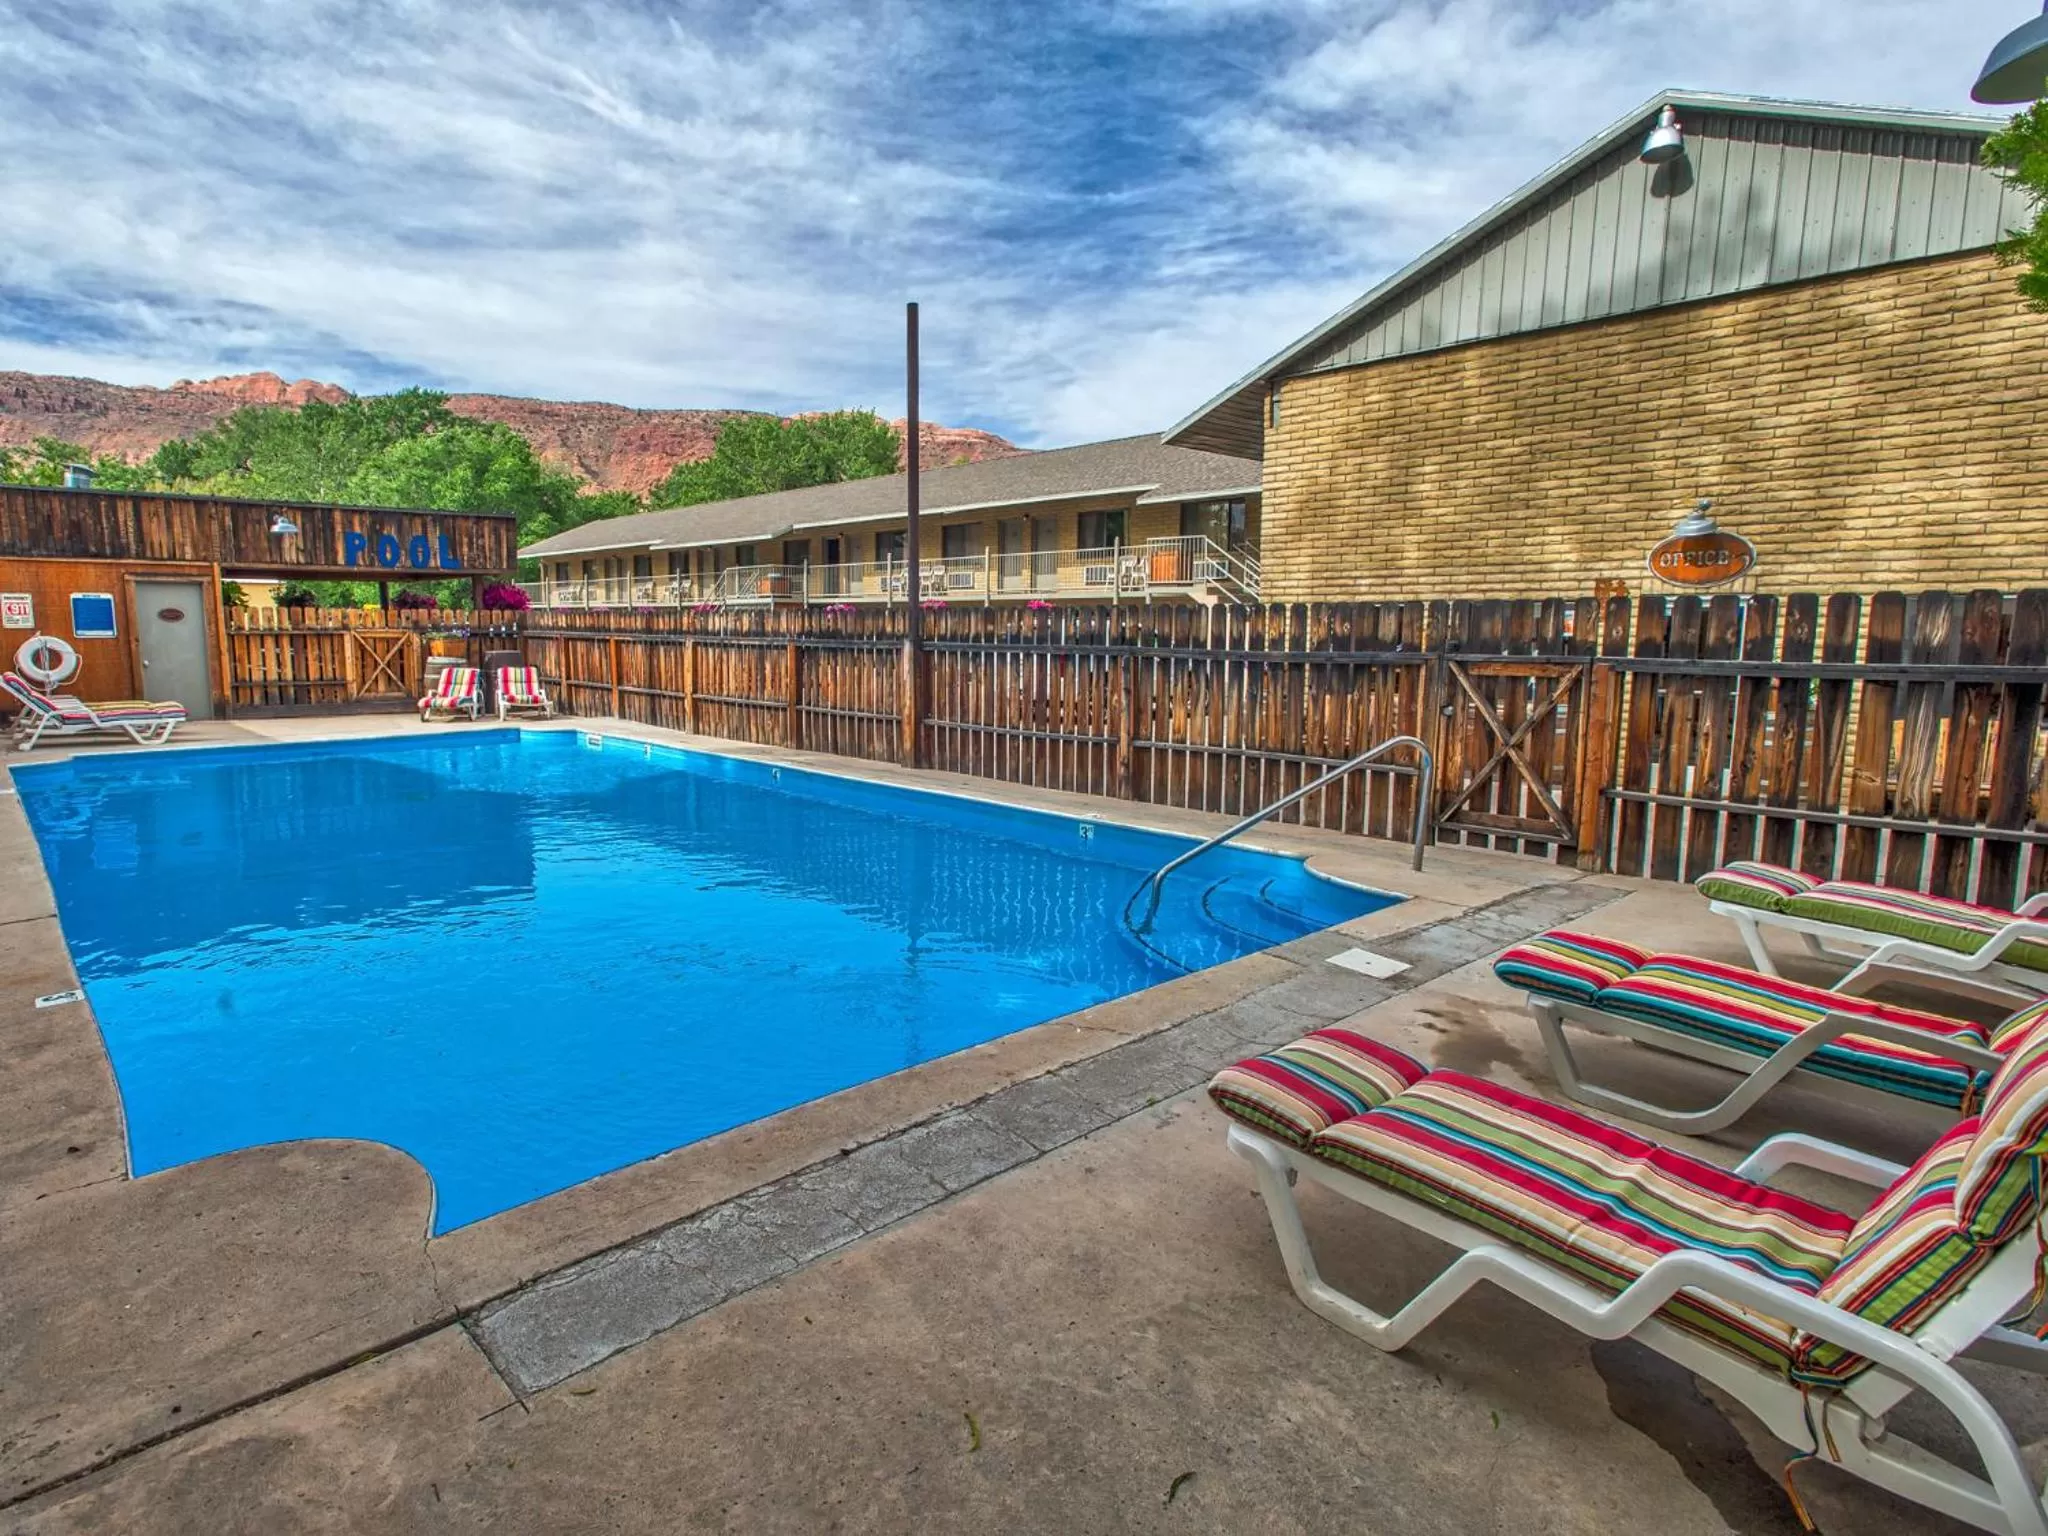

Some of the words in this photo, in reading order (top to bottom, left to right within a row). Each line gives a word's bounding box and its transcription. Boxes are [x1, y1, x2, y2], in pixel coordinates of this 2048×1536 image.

[344, 530, 461, 569] POOL
[1659, 550, 1729, 568] OFFICE
[11, 603, 30, 615] 911
